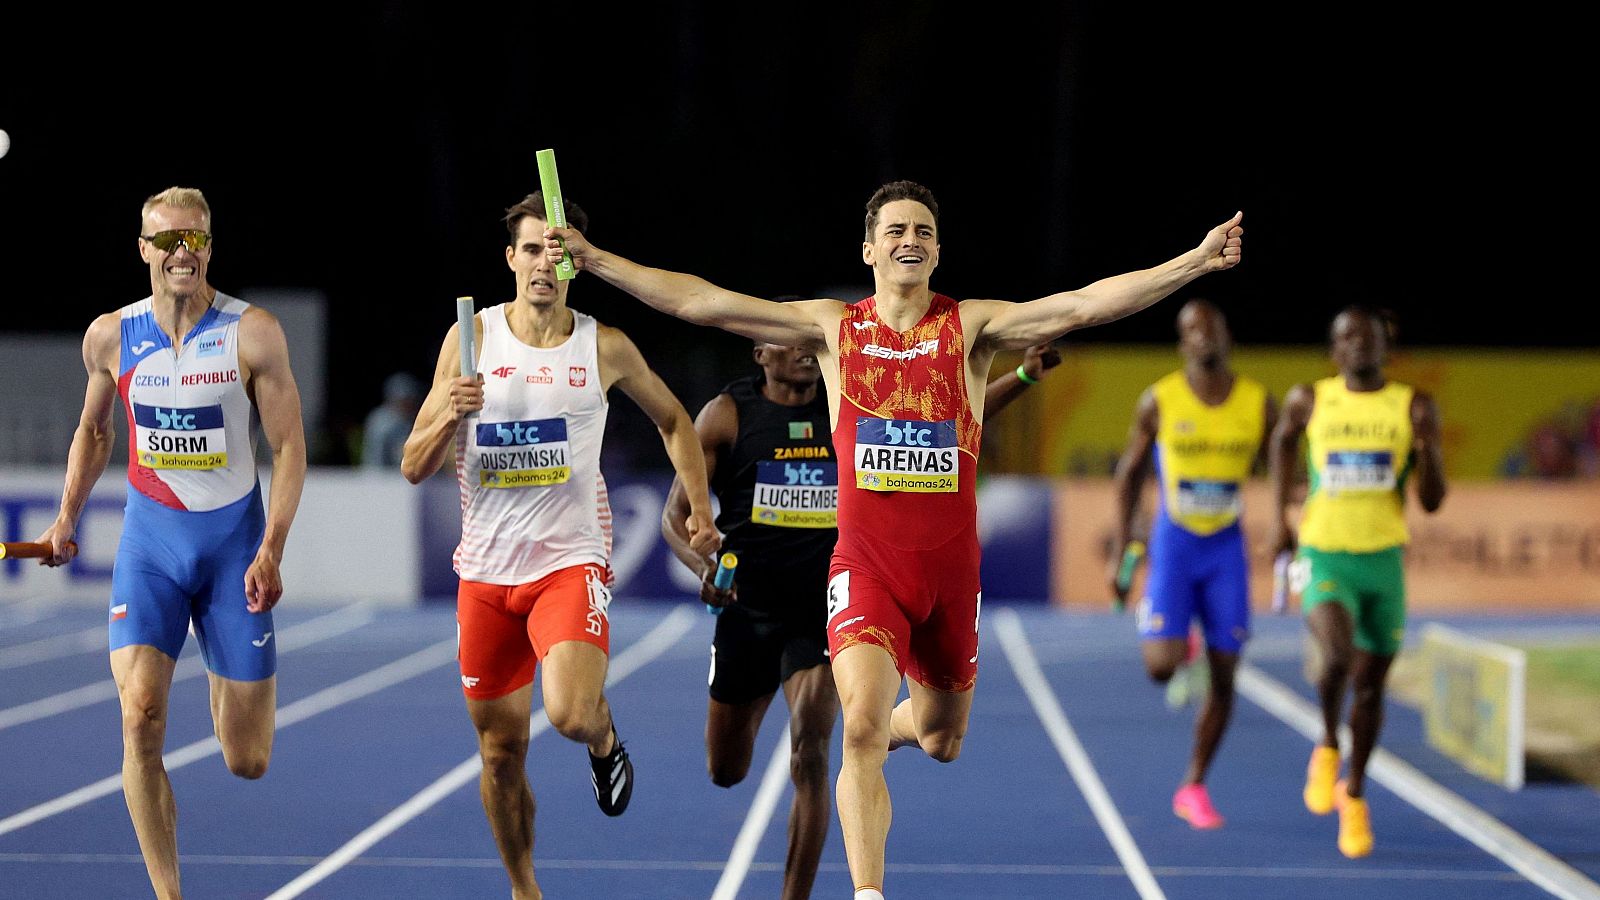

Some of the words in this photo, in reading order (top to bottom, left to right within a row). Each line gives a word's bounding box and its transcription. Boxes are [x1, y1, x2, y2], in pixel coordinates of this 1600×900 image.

[135, 375, 170, 387] CZECH
[181, 369, 238, 386] REPUBLIC
[491, 366, 517, 378] 4F
[155, 407, 197, 430] btc
[148, 431, 208, 453] ŠORM
[496, 422, 540, 445] btc
[885, 421, 932, 446] btc
[481, 447, 565, 470] DUSZYŃSKI
[774, 446, 829, 460] ZAMBIA
[861, 448, 953, 472] ARENAS
[784, 462, 824, 485] btc
[760, 487, 838, 509] LUCHEMBE
